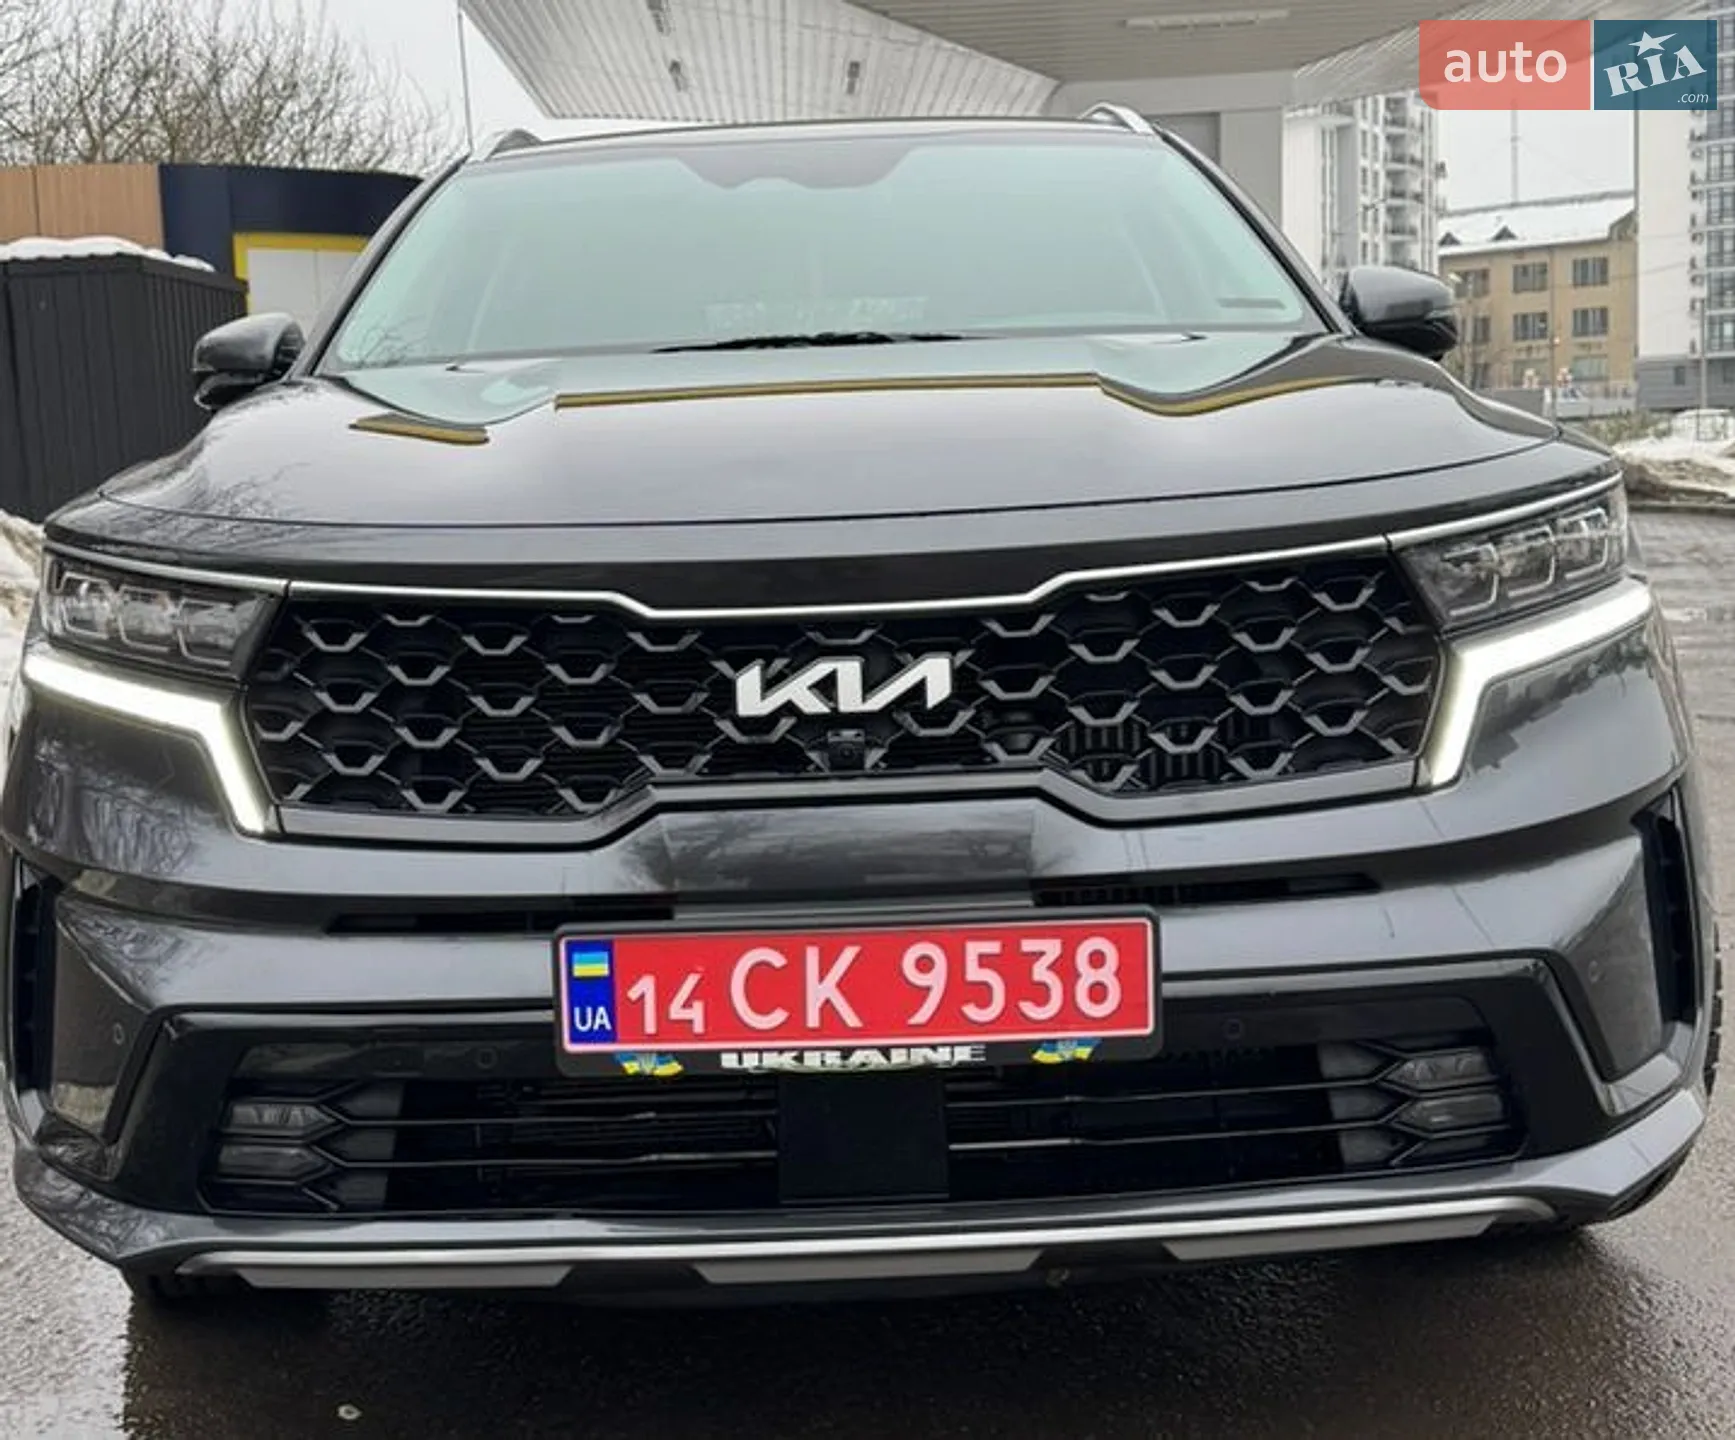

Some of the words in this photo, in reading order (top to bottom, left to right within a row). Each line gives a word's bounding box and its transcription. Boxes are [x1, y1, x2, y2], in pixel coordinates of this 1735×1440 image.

[735, 653, 952, 717] KIA
[627, 972, 705, 1036] 14
[730, 944, 864, 1031] CK
[901, 936, 1122, 1027] 9538
[573, 1006, 611, 1032] UA
[720, 1044, 986, 1070] UKRAINE
